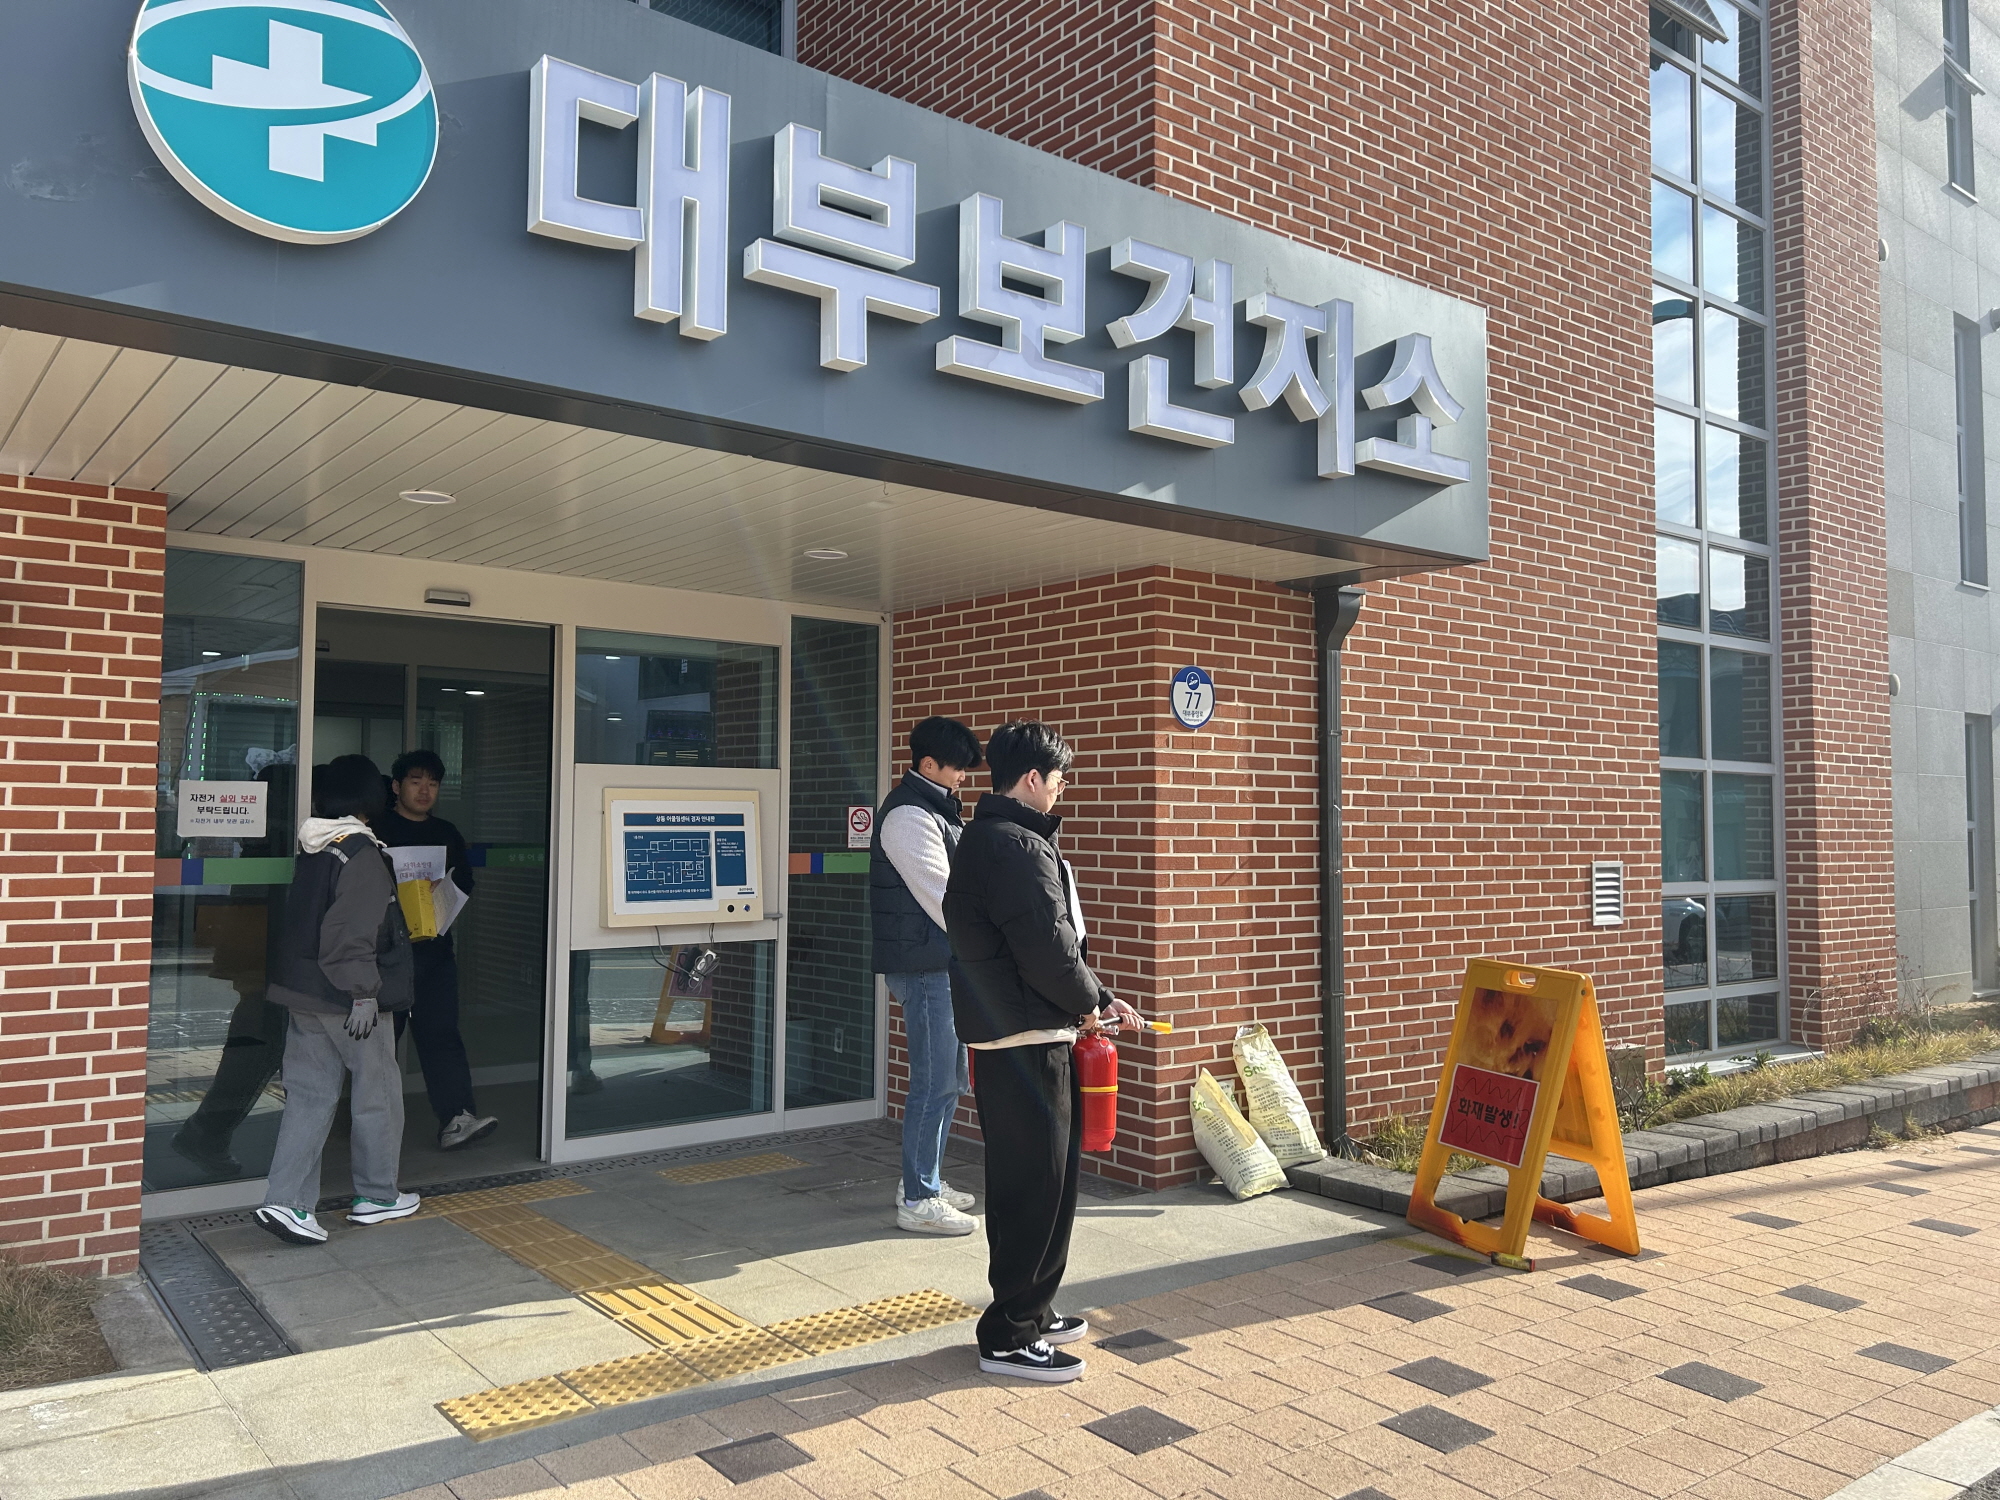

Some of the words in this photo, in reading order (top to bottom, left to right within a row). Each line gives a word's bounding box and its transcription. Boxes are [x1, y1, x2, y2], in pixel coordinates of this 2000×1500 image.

[528, 54, 1472, 486] 대부보건지소
[1185, 691, 1202, 710] 77
[190, 794, 215, 803] 자전거
[219, 794, 236, 803] 실외
[240, 794, 257, 803] 보관
[197, 806, 249, 815] 부탁드립니다.
[1457, 1097, 1520, 1129] 화재발생!
